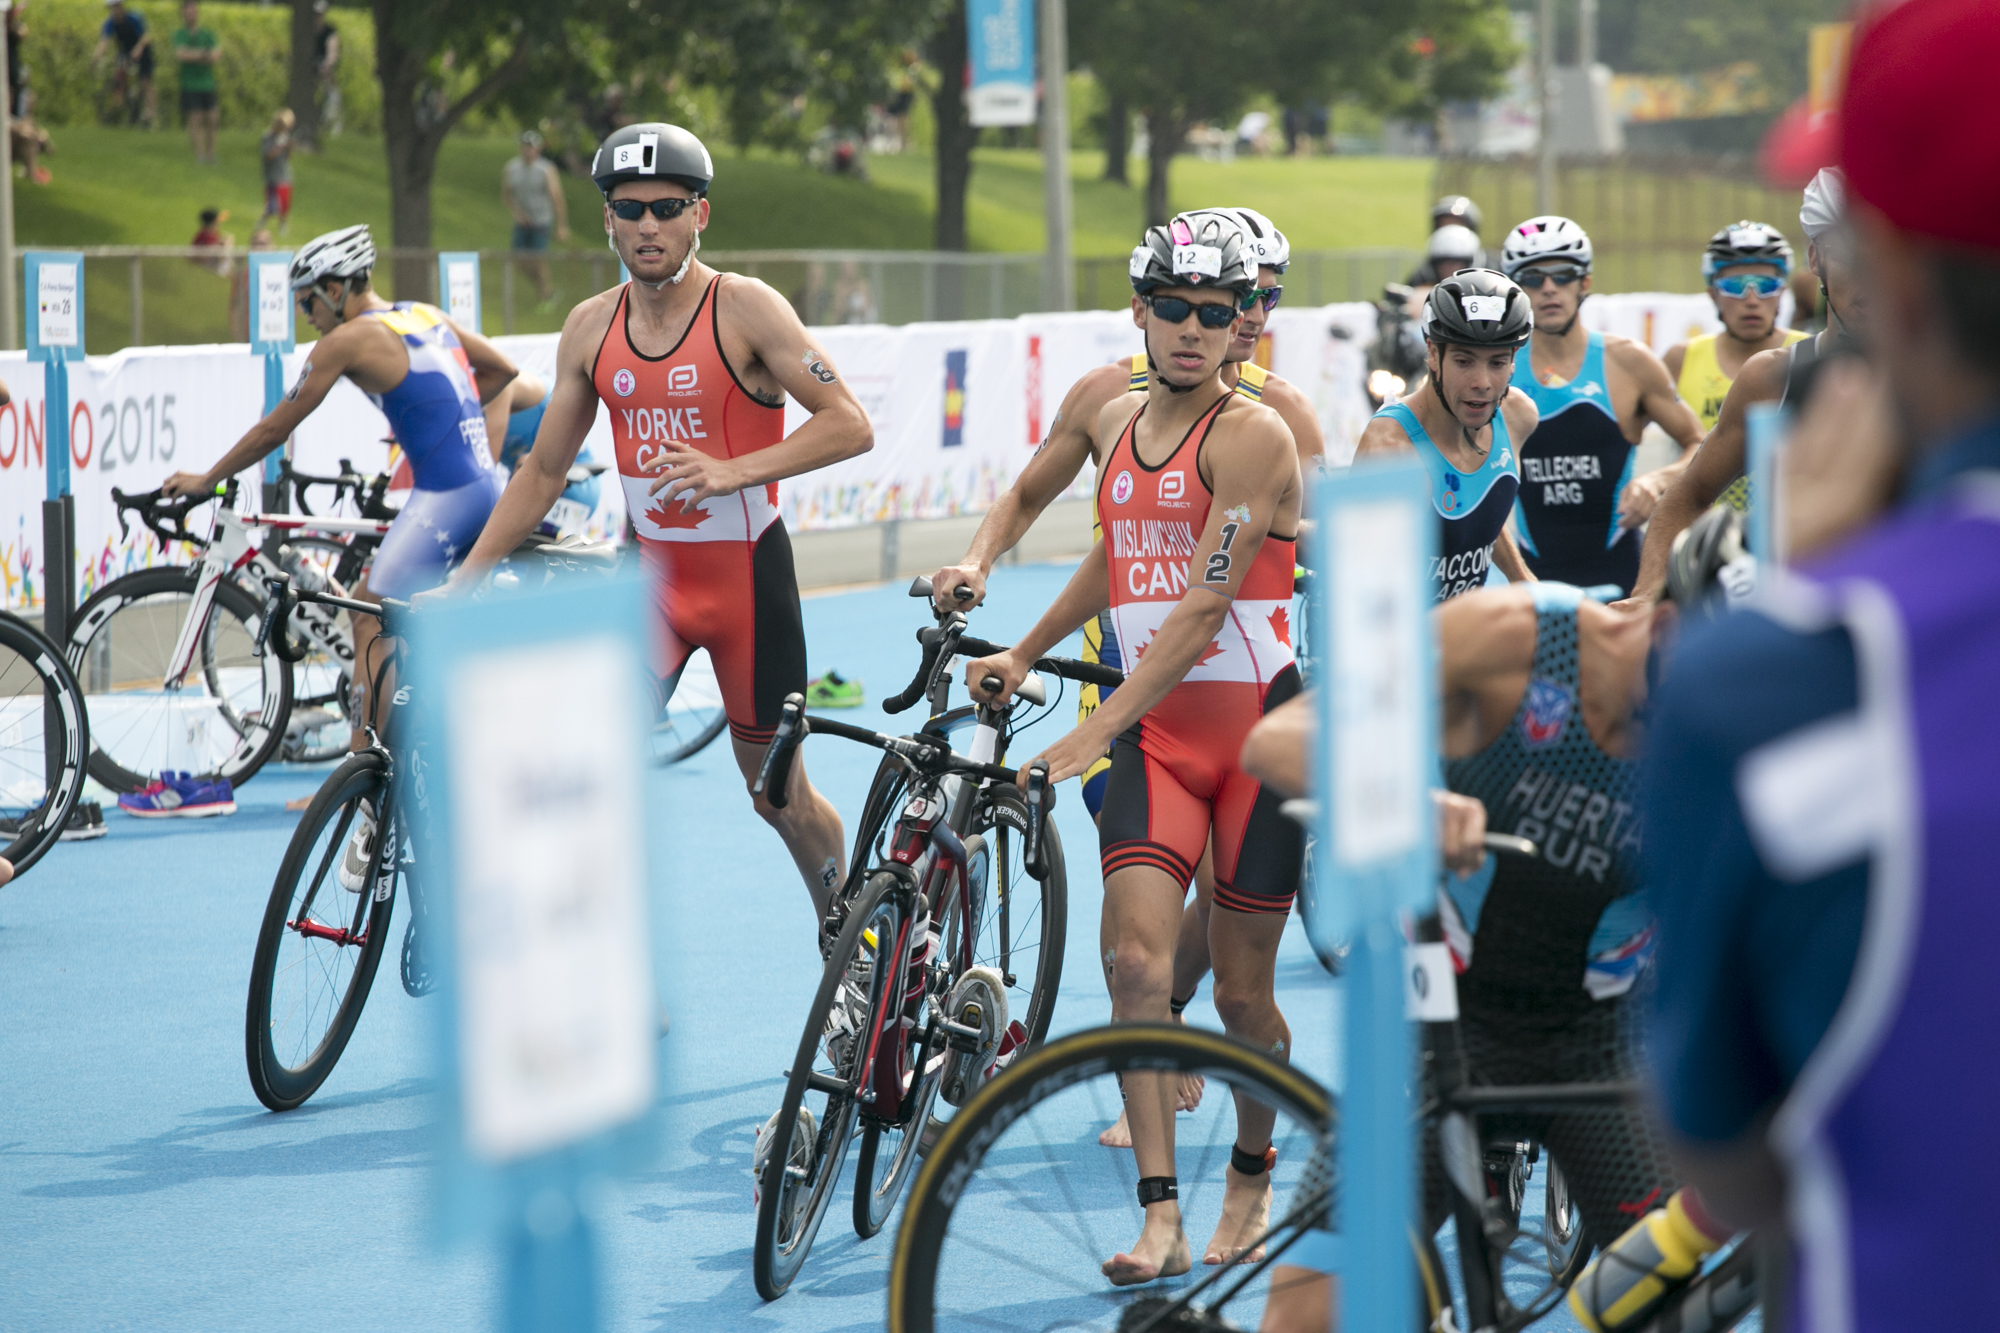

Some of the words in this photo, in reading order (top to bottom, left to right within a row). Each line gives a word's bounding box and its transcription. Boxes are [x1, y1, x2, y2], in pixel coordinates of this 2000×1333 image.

[620, 150, 629, 163] 8
[1176, 251, 1197, 265] 12
[1249, 243, 1266, 256] 16
[1469, 301, 1479, 314] 6
[808, 359, 838, 385] 8
[667, 389, 703, 397] PROJECT
[0, 397, 93, 470] ONO
[100, 392, 177, 473] 2015
[621, 407, 708, 441] YORKE
[636, 442, 691, 474] CA
[1522, 455, 1602, 483] TELLECHEA
[1157, 500, 1191, 508] PROJECT
[1543, 482, 1584, 506] ARG
[1112, 518, 1199, 559] MISLAWCHUK
[1128, 561, 1190, 597] CAN
[996, 805, 1028, 831] ONTRAGER
[380, 877, 388, 900] LAB
